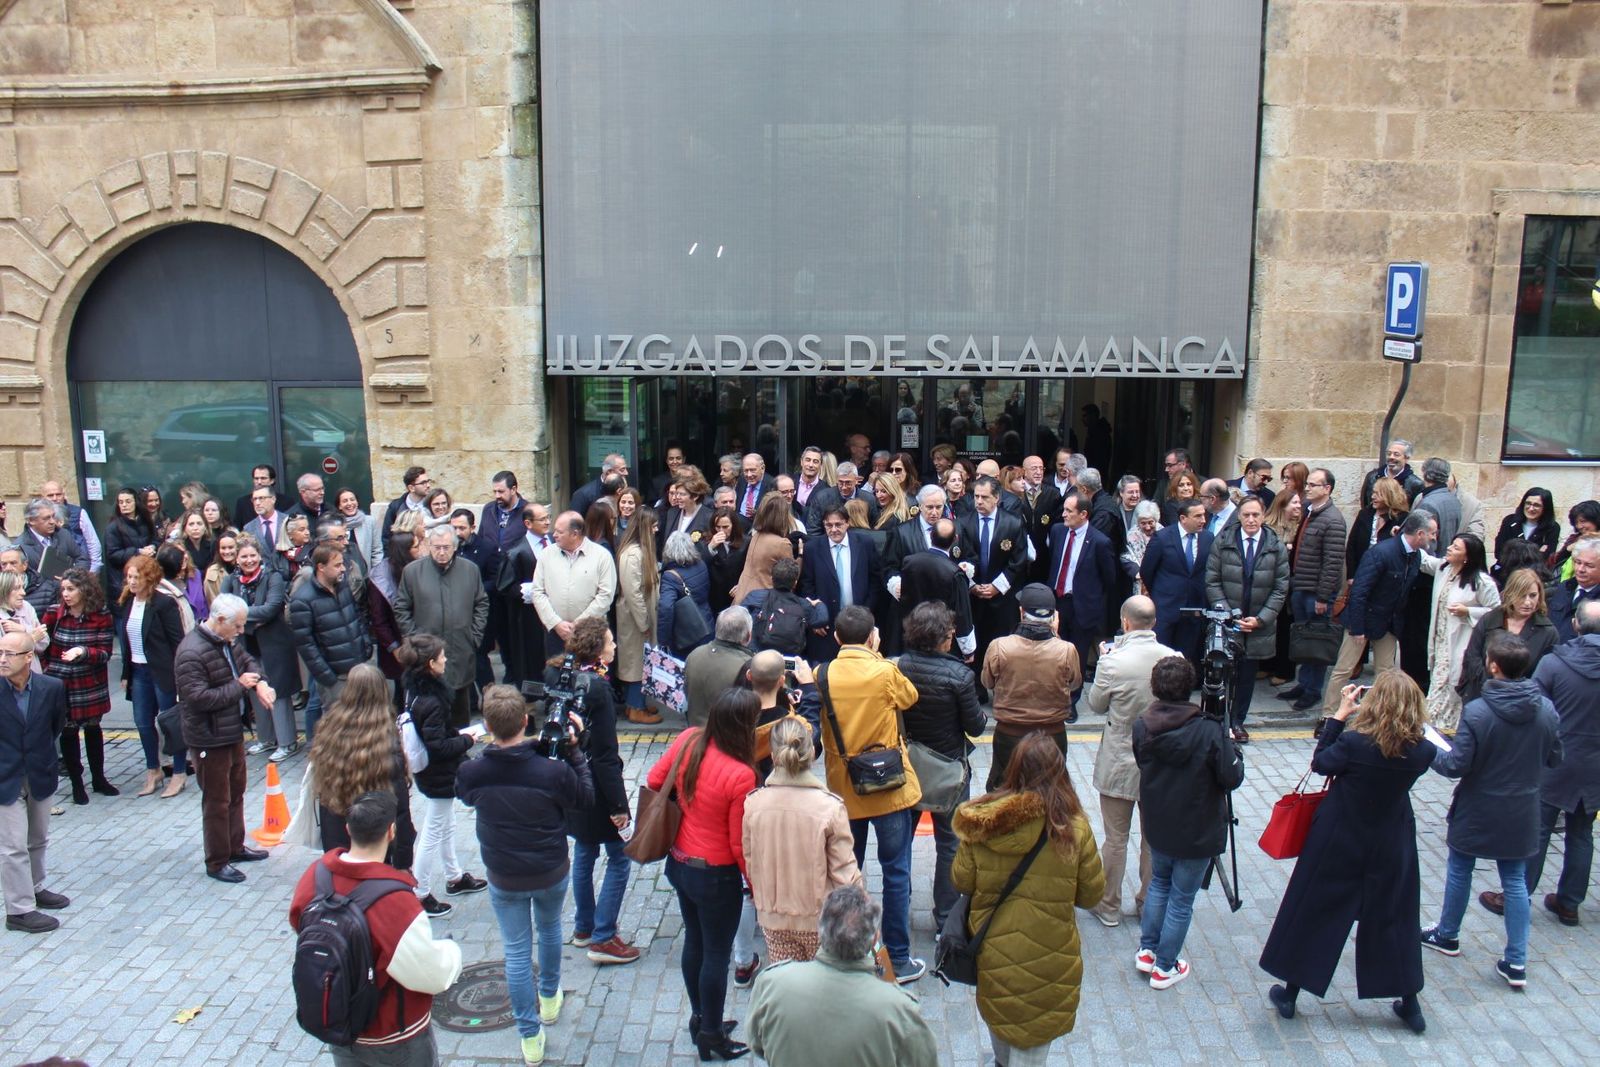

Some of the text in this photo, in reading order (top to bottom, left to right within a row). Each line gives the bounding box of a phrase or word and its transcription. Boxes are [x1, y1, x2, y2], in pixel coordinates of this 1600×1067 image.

[1390, 272, 1414, 327] P
[385, 328, 393, 344] 5
[549, 334, 1244, 375] JUZGADOS DE SALAMANCA
